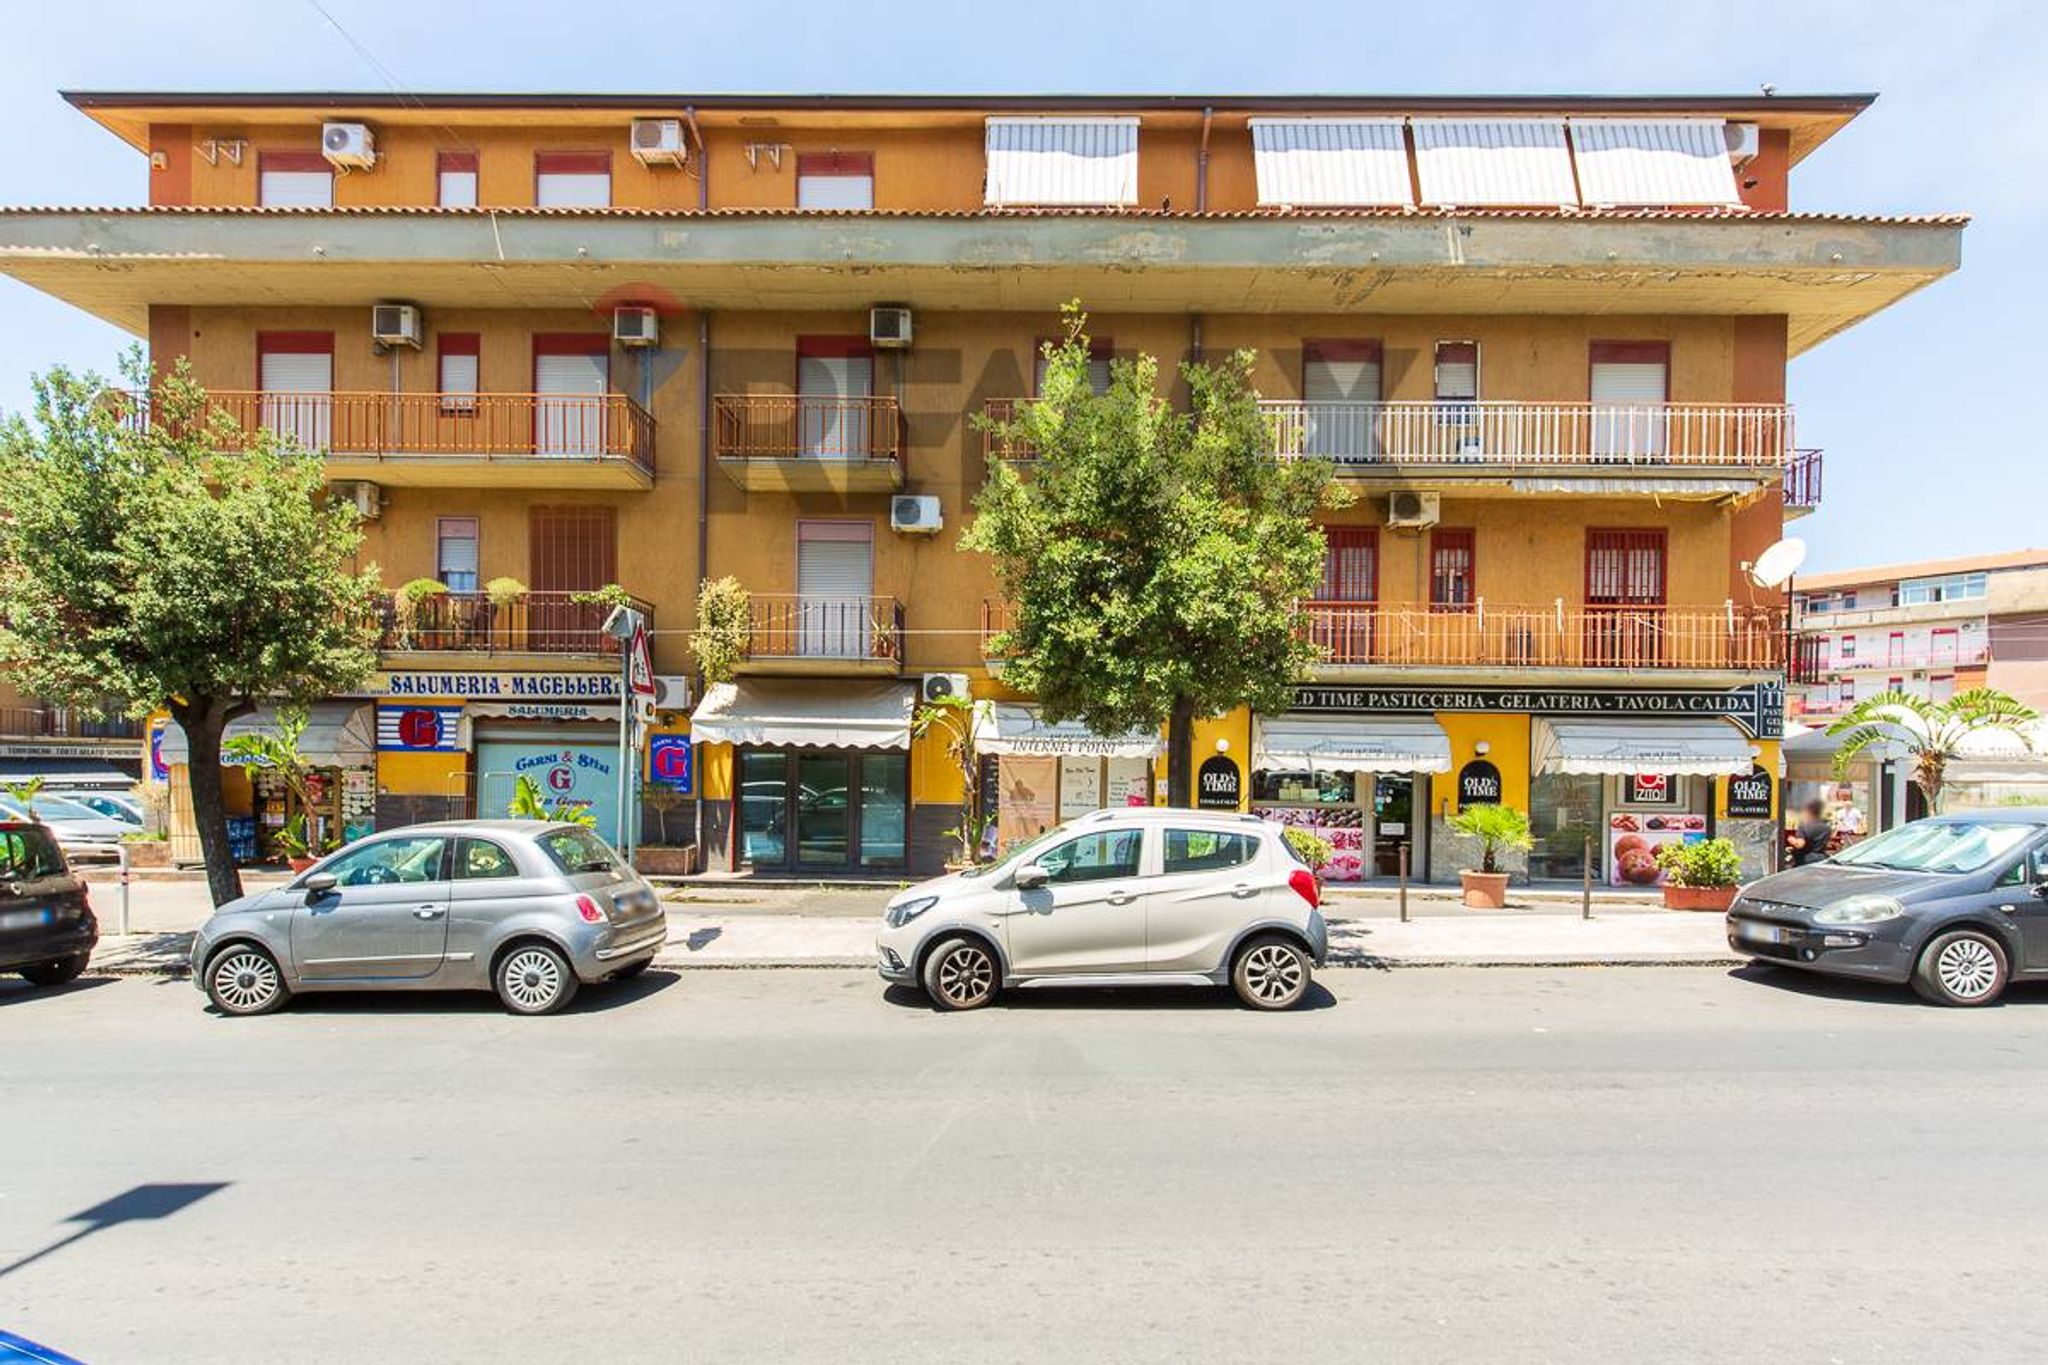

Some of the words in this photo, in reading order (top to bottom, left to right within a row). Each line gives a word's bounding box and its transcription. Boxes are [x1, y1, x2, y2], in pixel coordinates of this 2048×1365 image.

[391, 675, 501, 694] SALUMERIA
[1318, 693, 1363, 706] TIME
[1368, 693, 1485, 708] PASTICCERIA
[1500, 694, 1601, 709] GELATERIA
[1615, 696, 1686, 709] TAVOLA
[1689, 697, 1750, 709] CALDA
[1012, 740, 1074, 753] INTERNET
[1078, 740, 1117, 754] POINT
[1203, 772, 1230, 784] OLD
[1464, 777, 1491, 787] OLD
[1203, 781, 1237, 792] TIME
[1464, 786, 1498, 797] TIME
[1734, 781, 1761, 791] OLD
[1734, 790, 1768, 800] TIME
